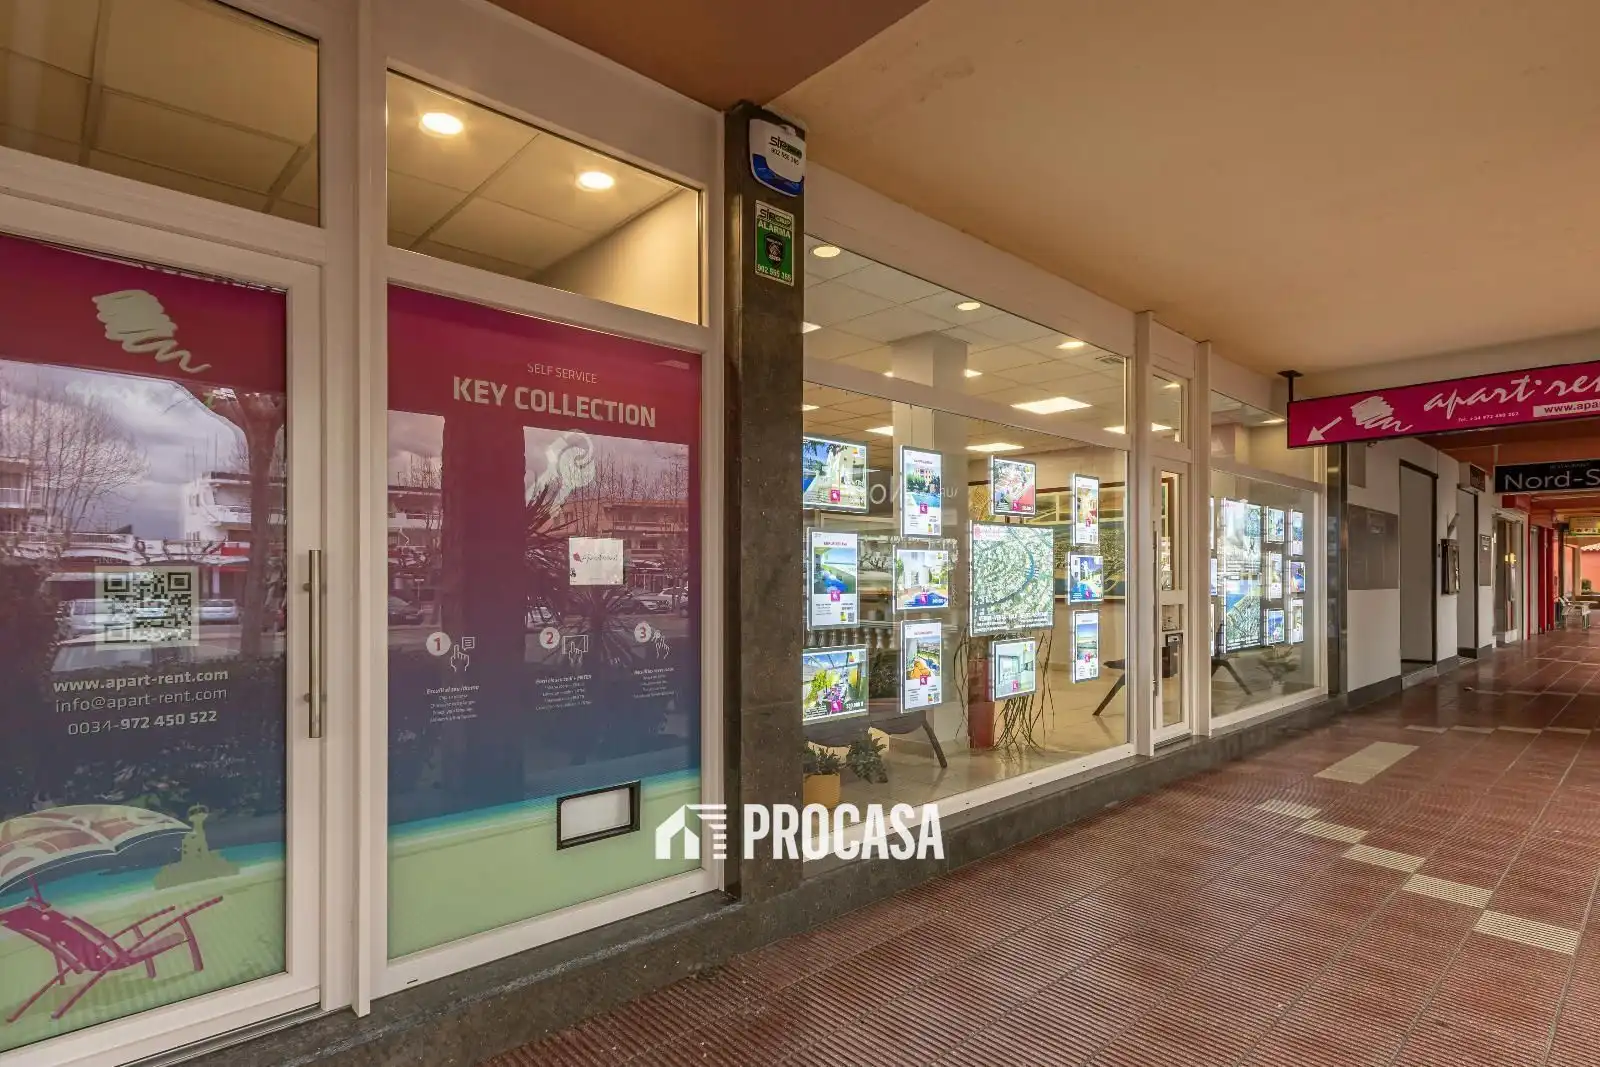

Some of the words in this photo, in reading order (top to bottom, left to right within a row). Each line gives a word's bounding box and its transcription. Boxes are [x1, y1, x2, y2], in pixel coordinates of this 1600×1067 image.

[758, 219, 791, 239] ALARMA
[527, 363, 553, 377] SELF
[555, 367, 598, 385] SERVICE
[453, 376, 508, 407] KEY
[514, 386, 656, 428] COLLECTION
[1544, 401, 1600, 413] www.apa
[546, 632, 554, 644] 2
[640, 628, 647, 639] 3
[433, 638, 442, 651] 1
[53, 669, 228, 692] www.apart-rent.com
[55, 688, 228, 713] info@apart-rent.com
[68, 716, 150, 735] 0034-972
[153, 713, 185, 727] 450
[189, 710, 217, 724] 522
